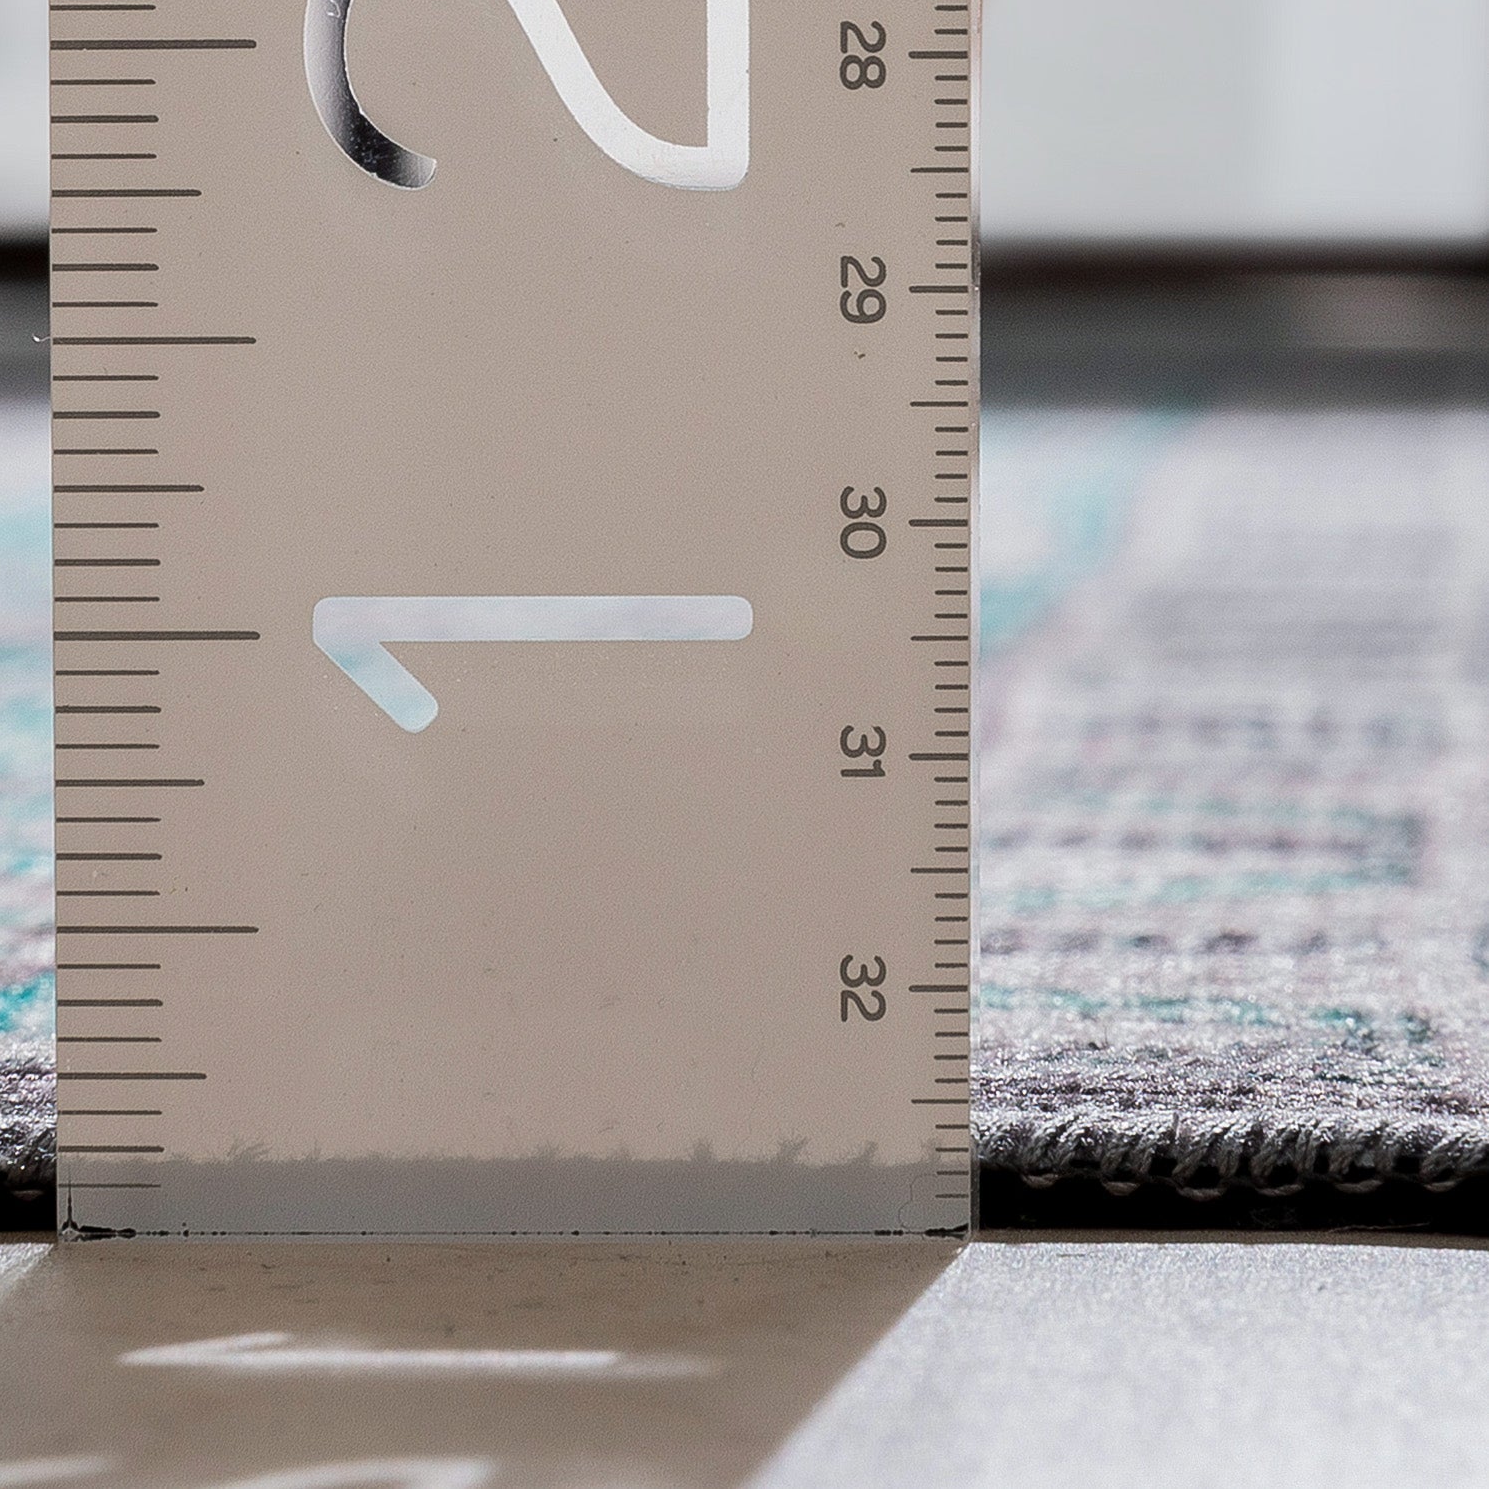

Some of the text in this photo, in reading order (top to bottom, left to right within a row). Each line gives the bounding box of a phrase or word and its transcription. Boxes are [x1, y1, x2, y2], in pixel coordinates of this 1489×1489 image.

[839, 21, 886, 90] 28
[839, 256, 887, 326] 29
[839, 486, 887, 559] 30
[312, 595, 754, 734] 1
[839, 725, 886, 780] 31
[839, 955, 886, 1024] 32
